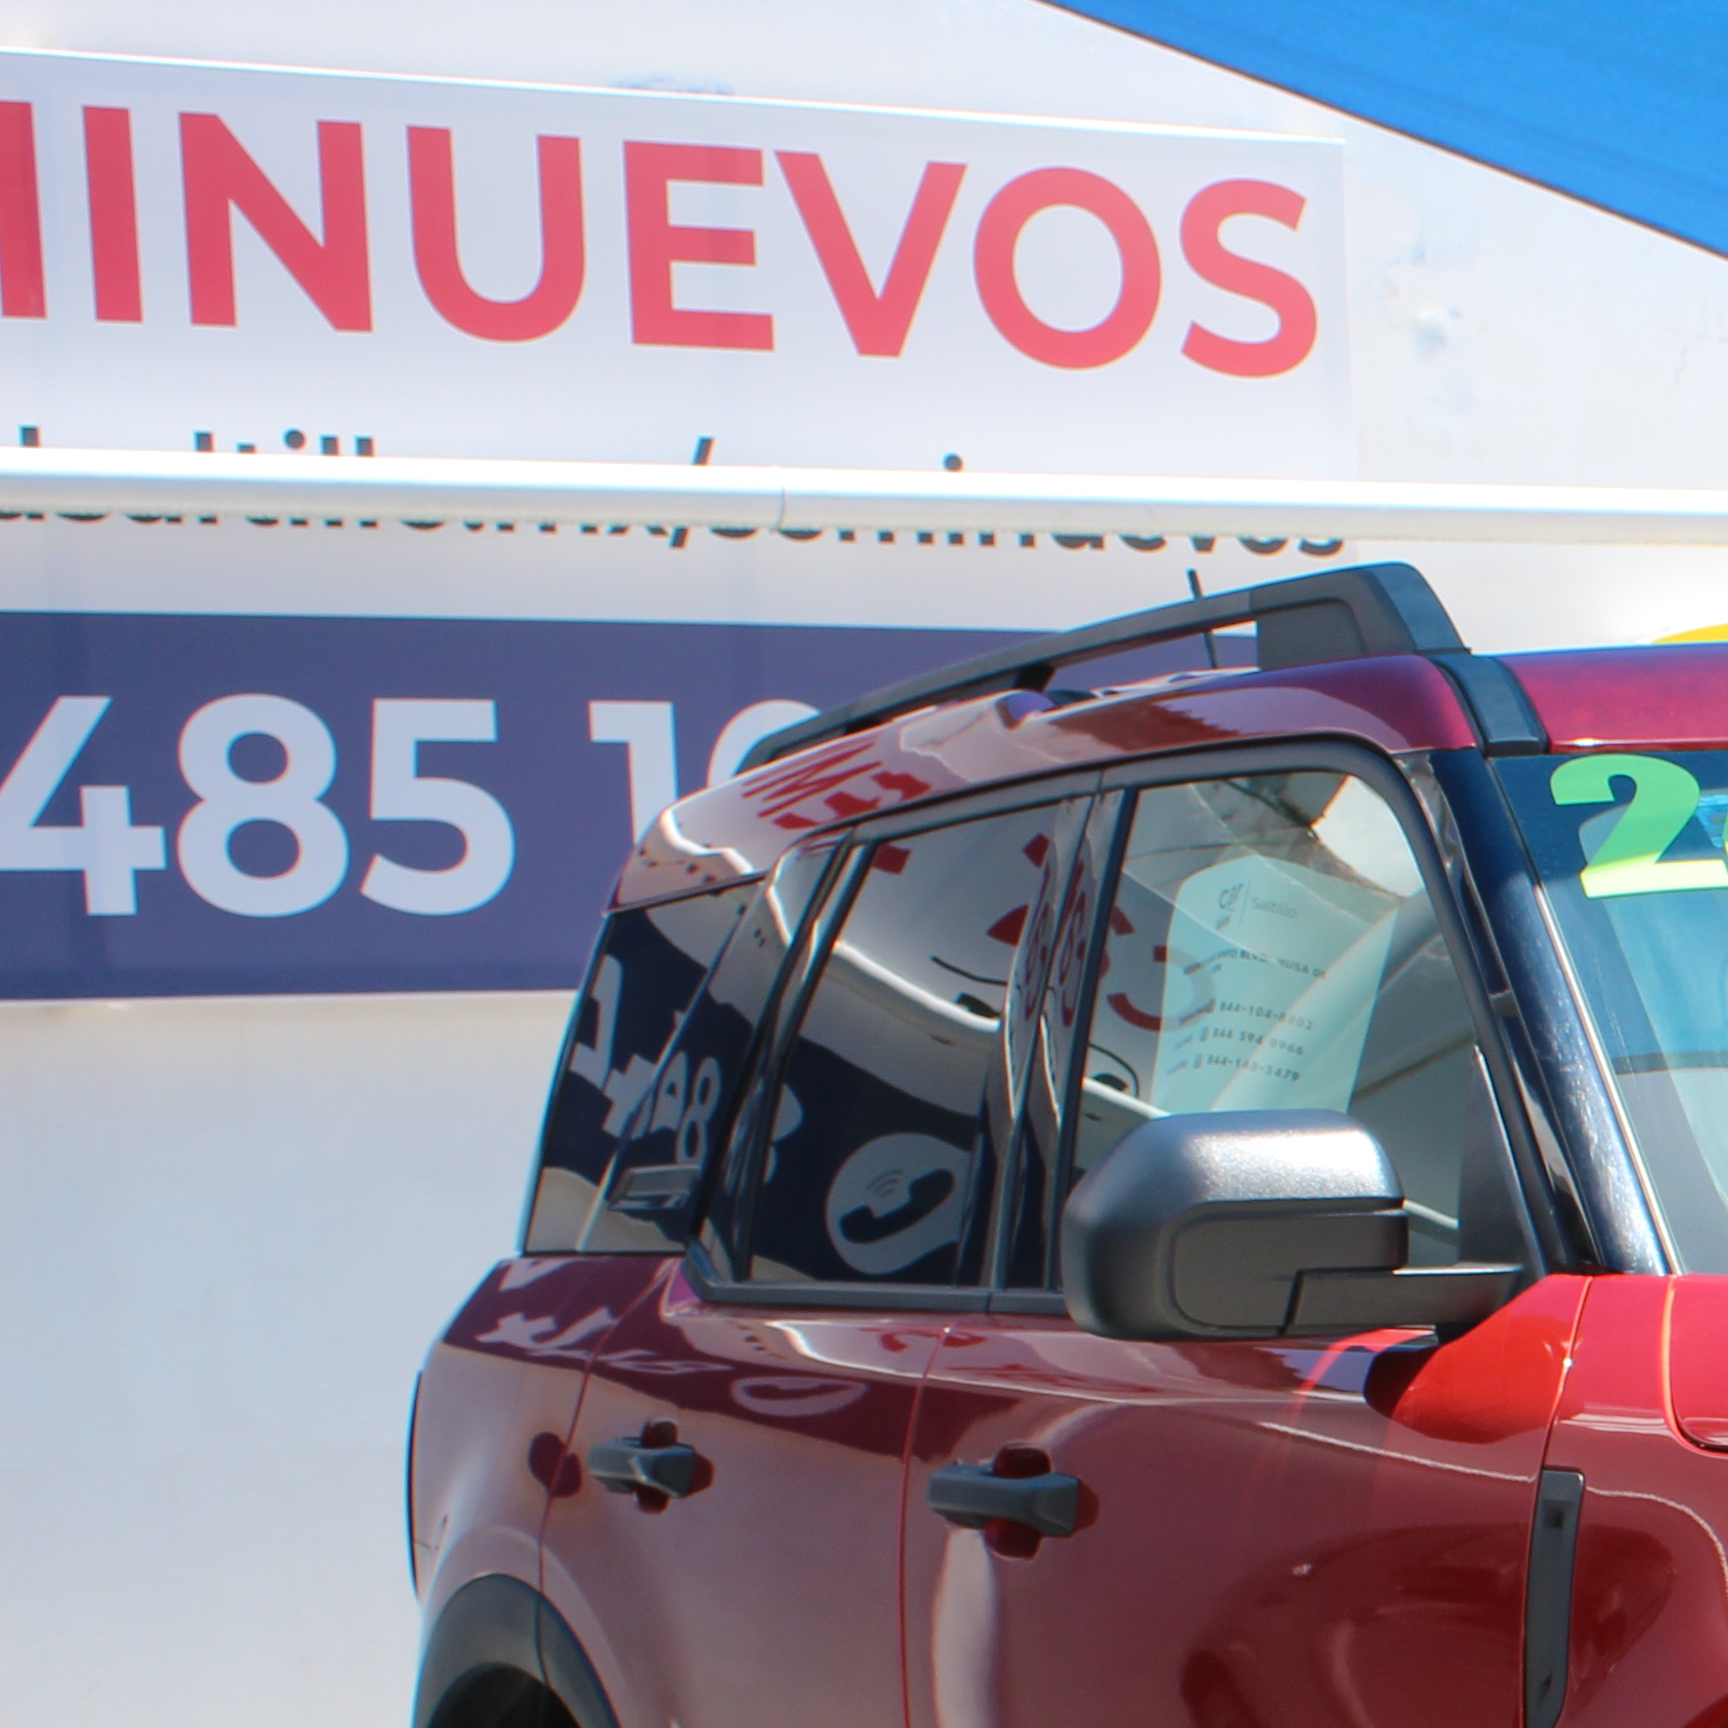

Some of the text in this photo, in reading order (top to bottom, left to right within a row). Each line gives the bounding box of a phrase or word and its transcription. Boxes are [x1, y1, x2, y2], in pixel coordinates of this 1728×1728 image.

[0, 98, 1320, 379] INUEVOS
[0, 693, 516, 919] 485
[1250, 895, 1298, 919] Saltillo
